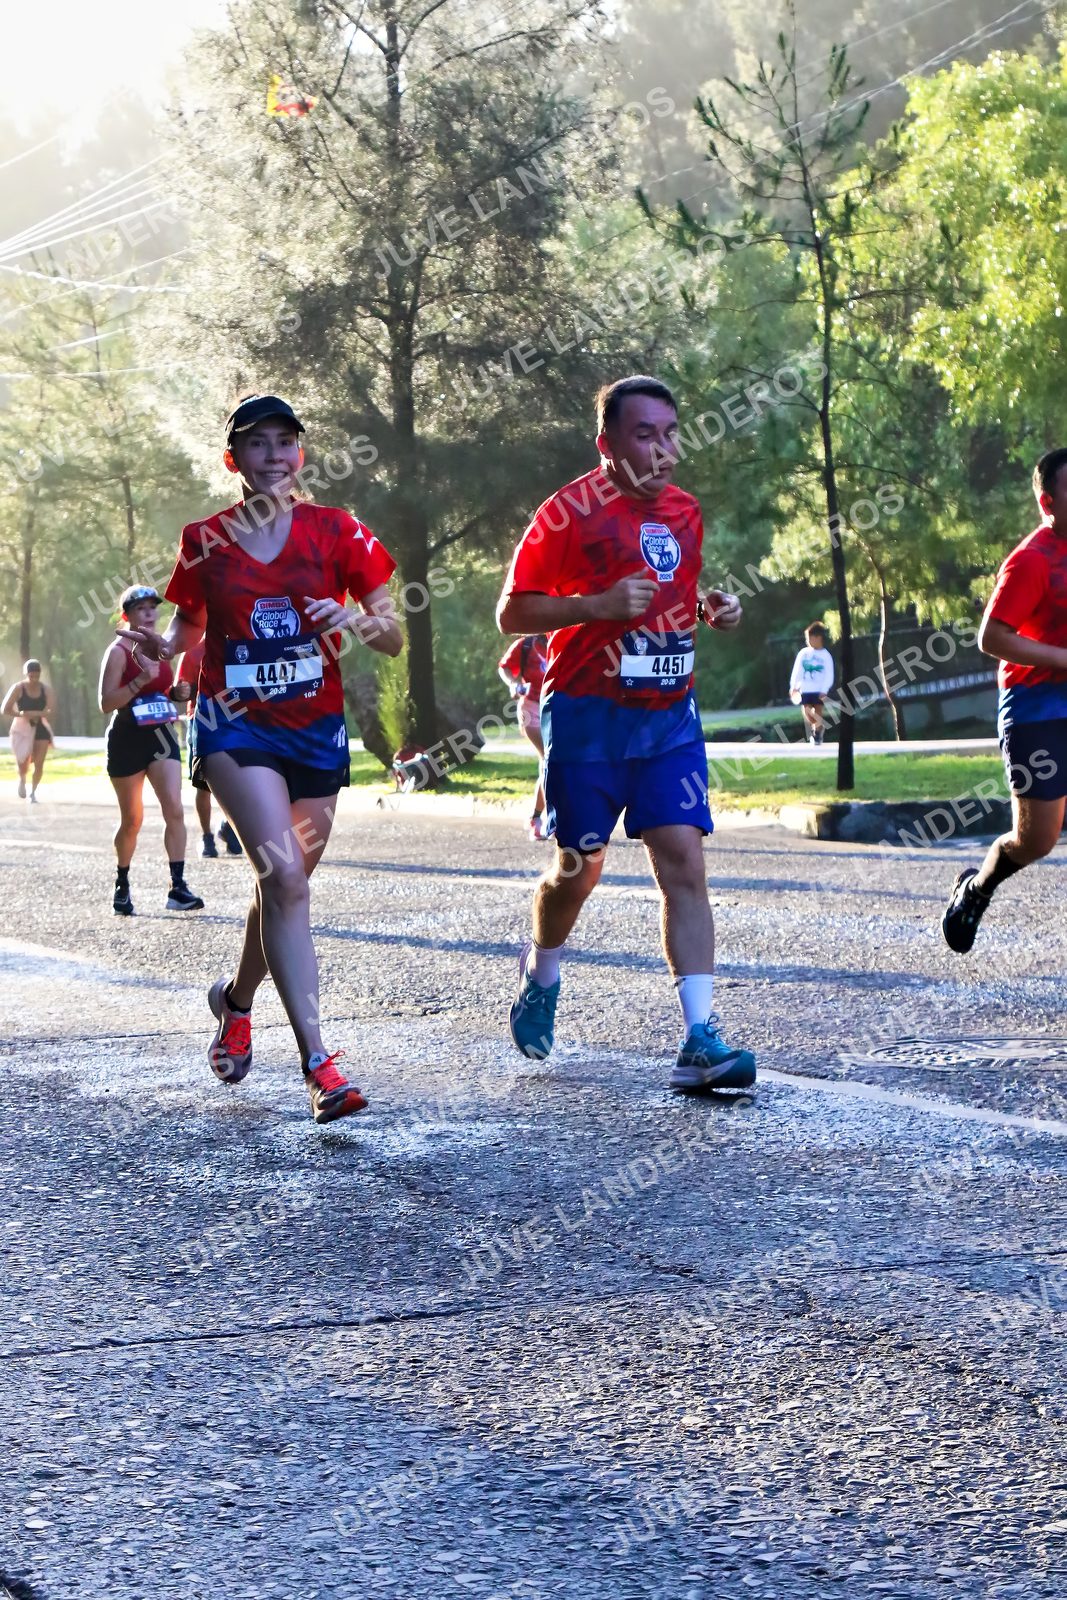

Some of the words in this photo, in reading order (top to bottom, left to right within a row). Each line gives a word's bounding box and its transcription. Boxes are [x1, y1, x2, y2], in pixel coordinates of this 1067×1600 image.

[649, 536, 668, 546] Global
[648, 545, 662, 554] Race
[262, 610, 287, 620] Global
[259, 620, 278, 628] Race
[652, 656, 684, 675] 4451
[256, 662, 297, 685] 4447
[304, 690, 317, 698] 10K
